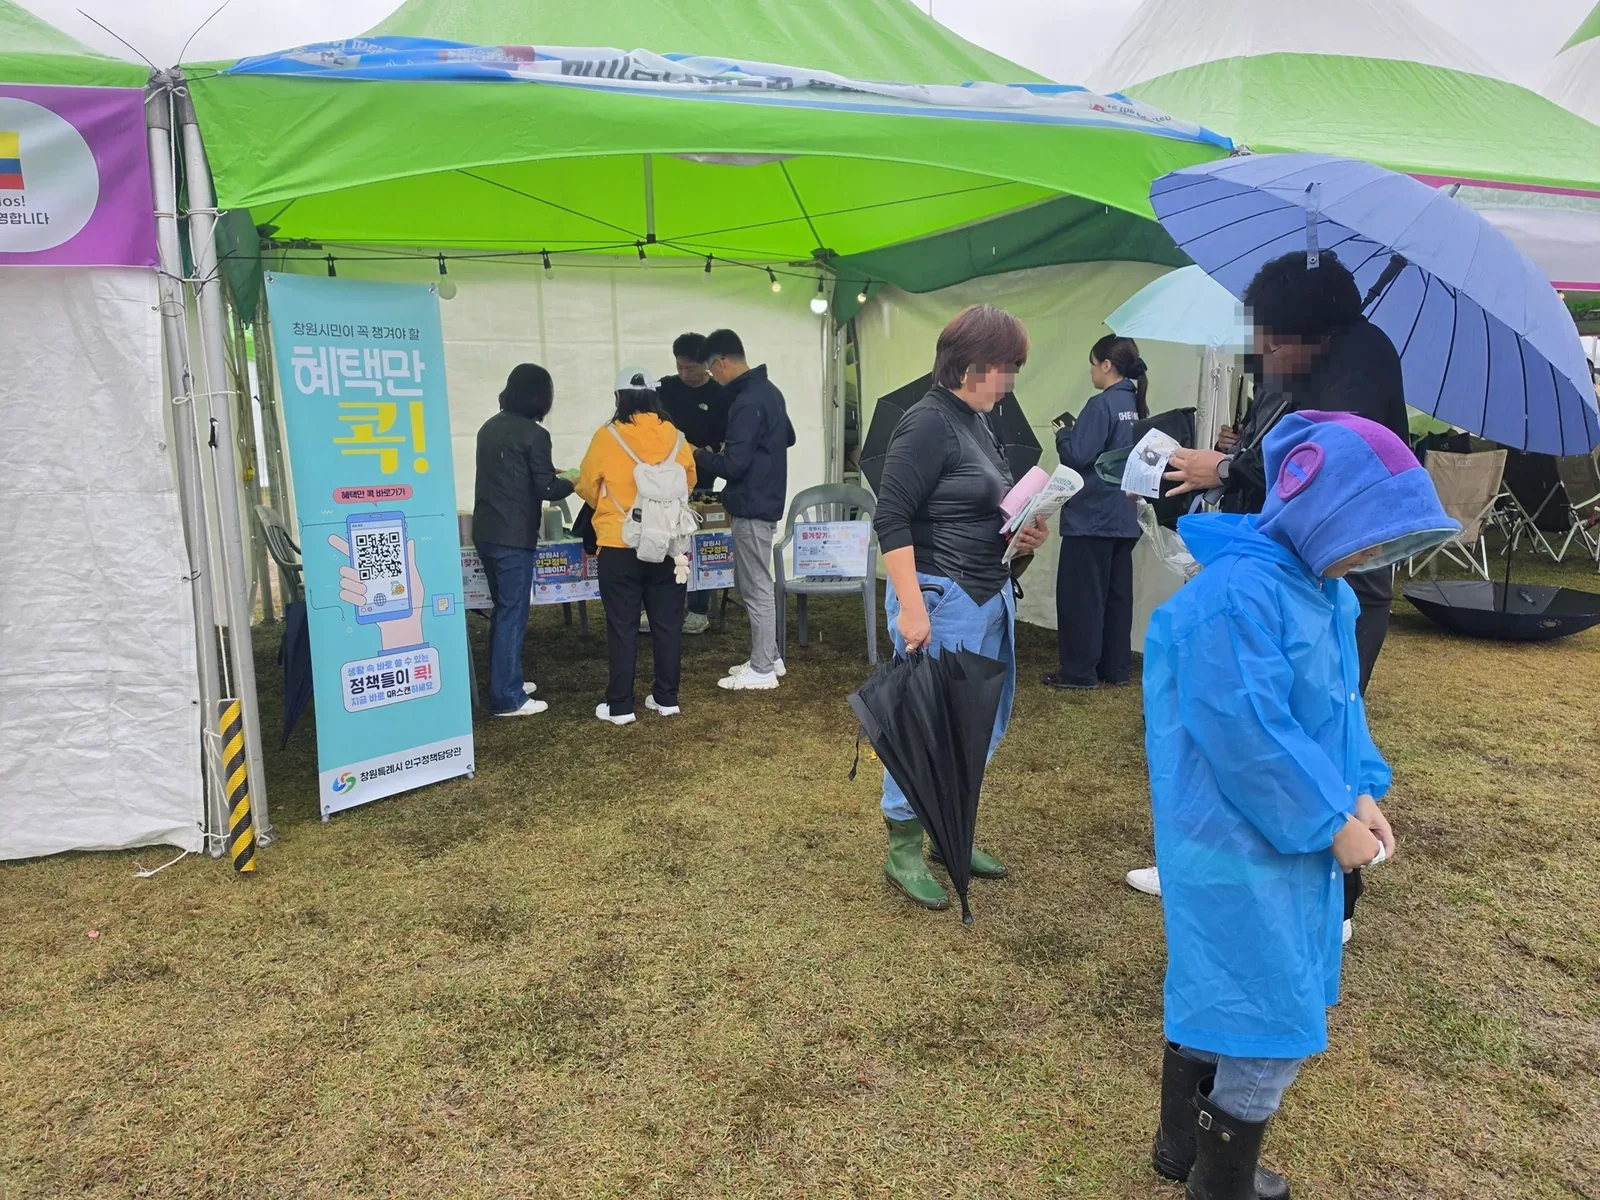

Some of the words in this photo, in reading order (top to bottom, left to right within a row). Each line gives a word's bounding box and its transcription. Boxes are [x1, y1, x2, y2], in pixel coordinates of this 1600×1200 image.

[0, 195, 26, 207] os!
[292, 321, 354, 338] 창원시민이
[357, 324, 369, 339] 꼭
[371, 326, 406, 340] 챙겨야
[408, 328, 420, 341] 할
[291, 346, 426, 397] 혜택만
[333, 401, 430, 475] 콕!
[341, 490, 365, 500] 혜택만
[376, 487, 406, 498] 바로가기
[347, 665, 365, 677] 생활
[366, 663, 375, 673] 속
[376, 660, 393, 671] 바로
[404, 656, 413, 666] 수
[413, 653, 429, 664] 있는
[349, 668, 410, 695] 정책들이
[413, 663, 433, 680] 콕!
[351, 695, 368, 707] 지금
[368, 691, 386, 703] 바로
[386, 681, 433, 699] QR스캔하세요
[360, 761, 404, 782] 창원특례시
[404, 746, 462, 770] 인구정책담당관
